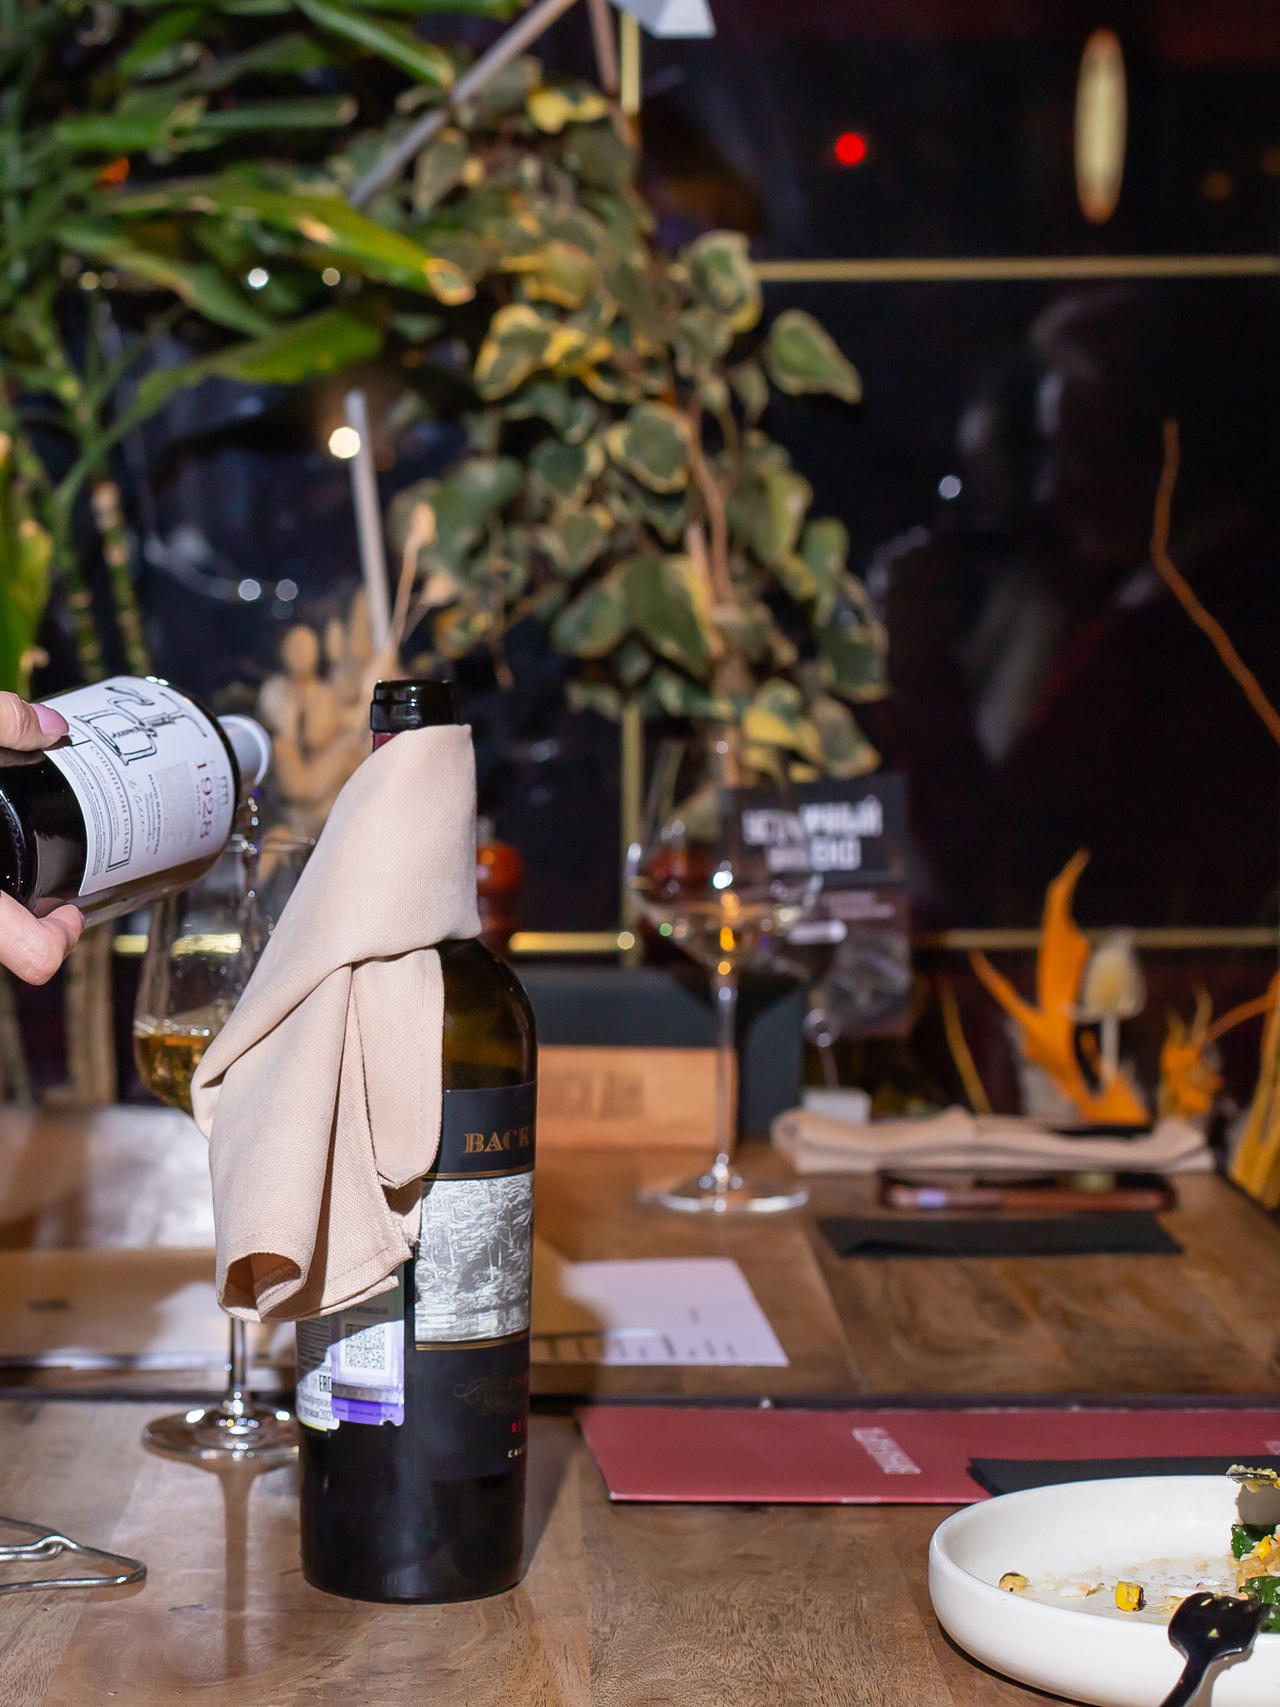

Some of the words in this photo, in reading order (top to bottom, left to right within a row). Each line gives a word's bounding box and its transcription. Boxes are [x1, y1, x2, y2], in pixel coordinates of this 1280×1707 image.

[90, 745, 129, 813] СОВИНЬОН
[148, 774, 159, 799] HAND
[195, 760, 214, 839] 1928
[153, 801, 162, 855] HARVESTED
